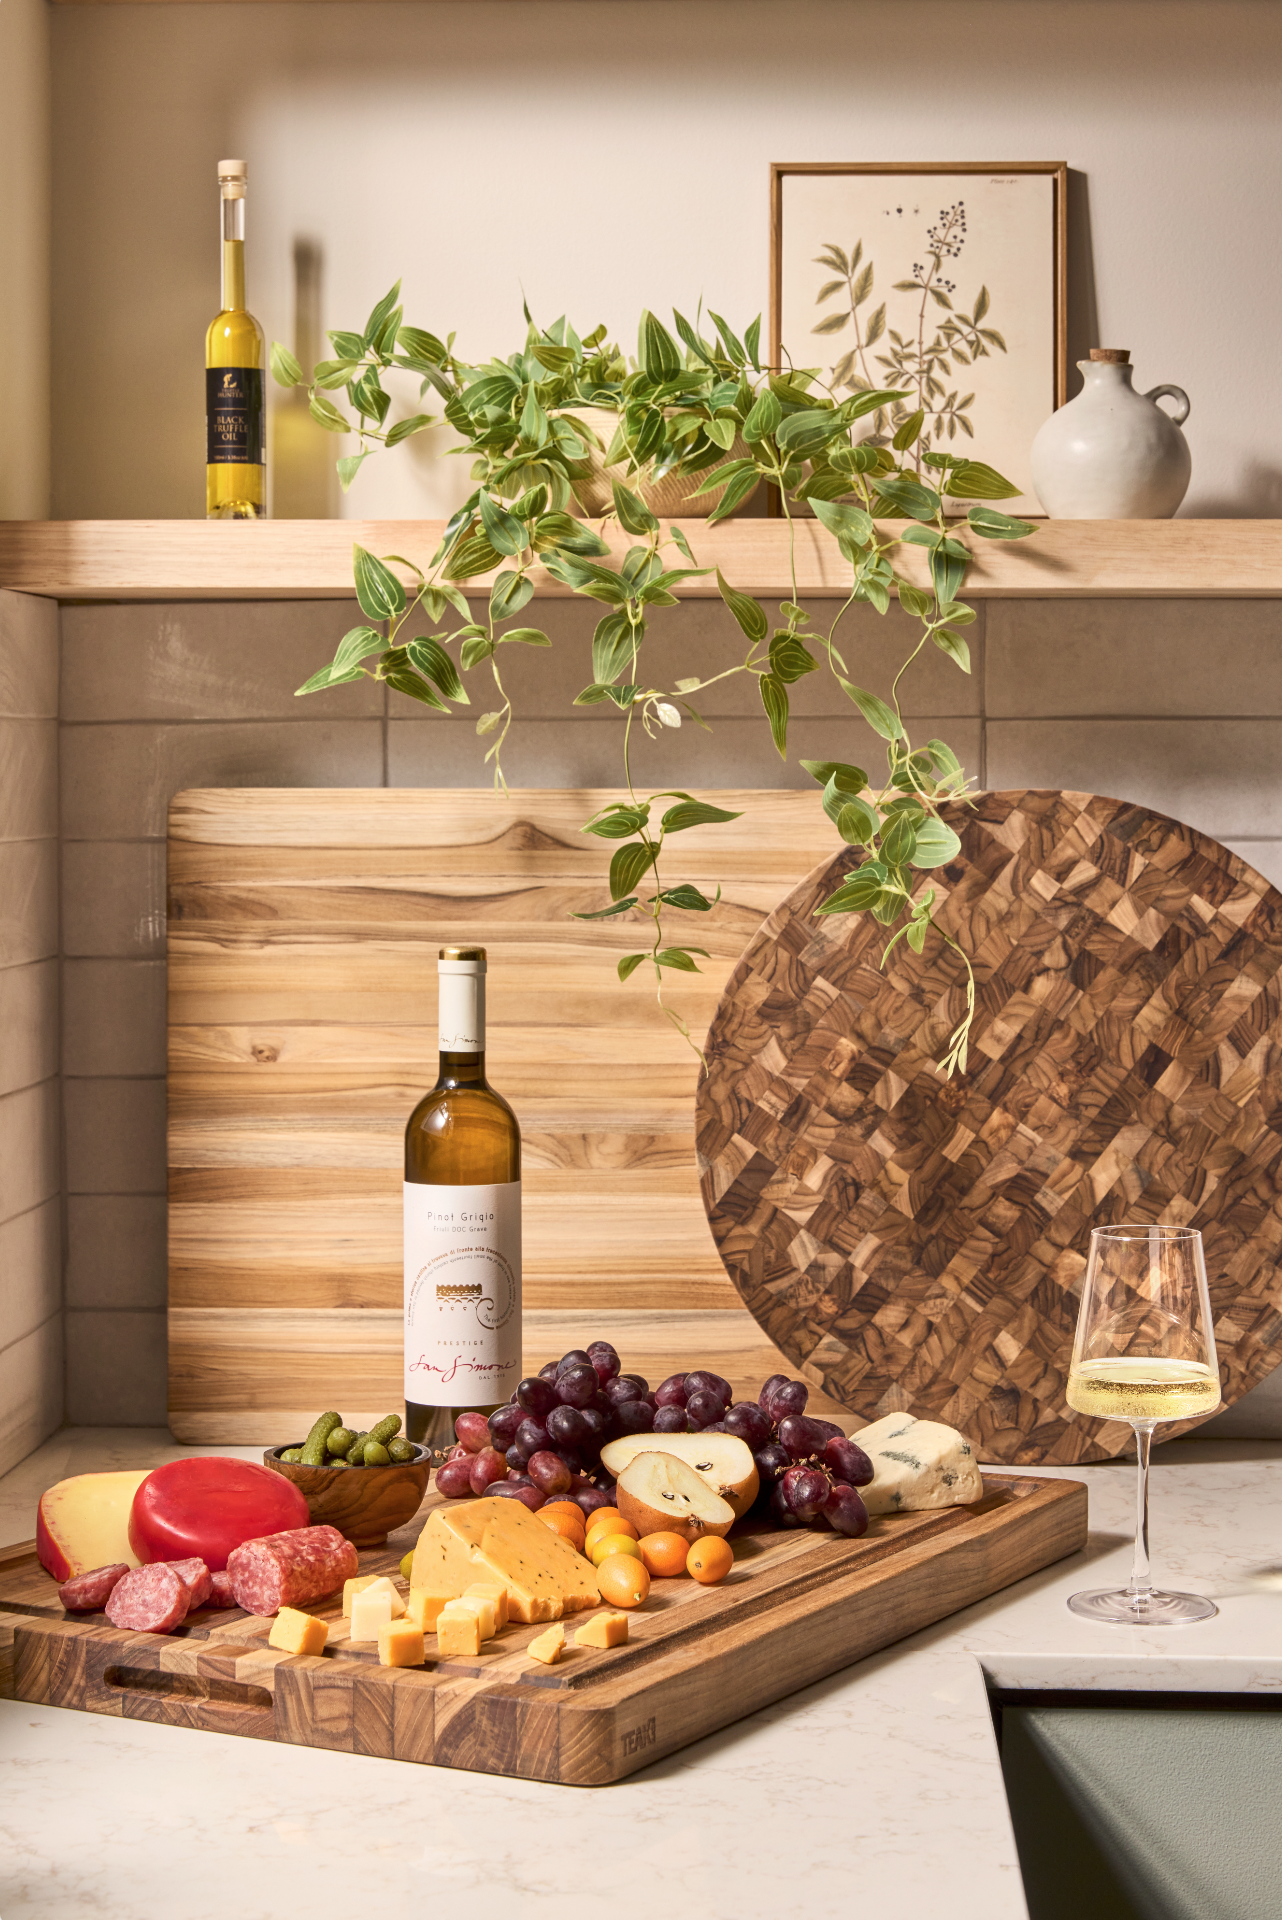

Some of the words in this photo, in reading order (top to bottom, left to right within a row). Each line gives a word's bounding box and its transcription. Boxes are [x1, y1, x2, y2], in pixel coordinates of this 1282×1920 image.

[217, 416, 244, 424] BLACK
[213, 425, 249, 433] TRUFFLE
[221, 432, 238, 441] OIL
[427, 1211, 454, 1221] Pinot
[460, 1212, 495, 1223] Grigio
[408, 1354, 447, 1373] San
[441, 1355, 518, 1383] Simone
